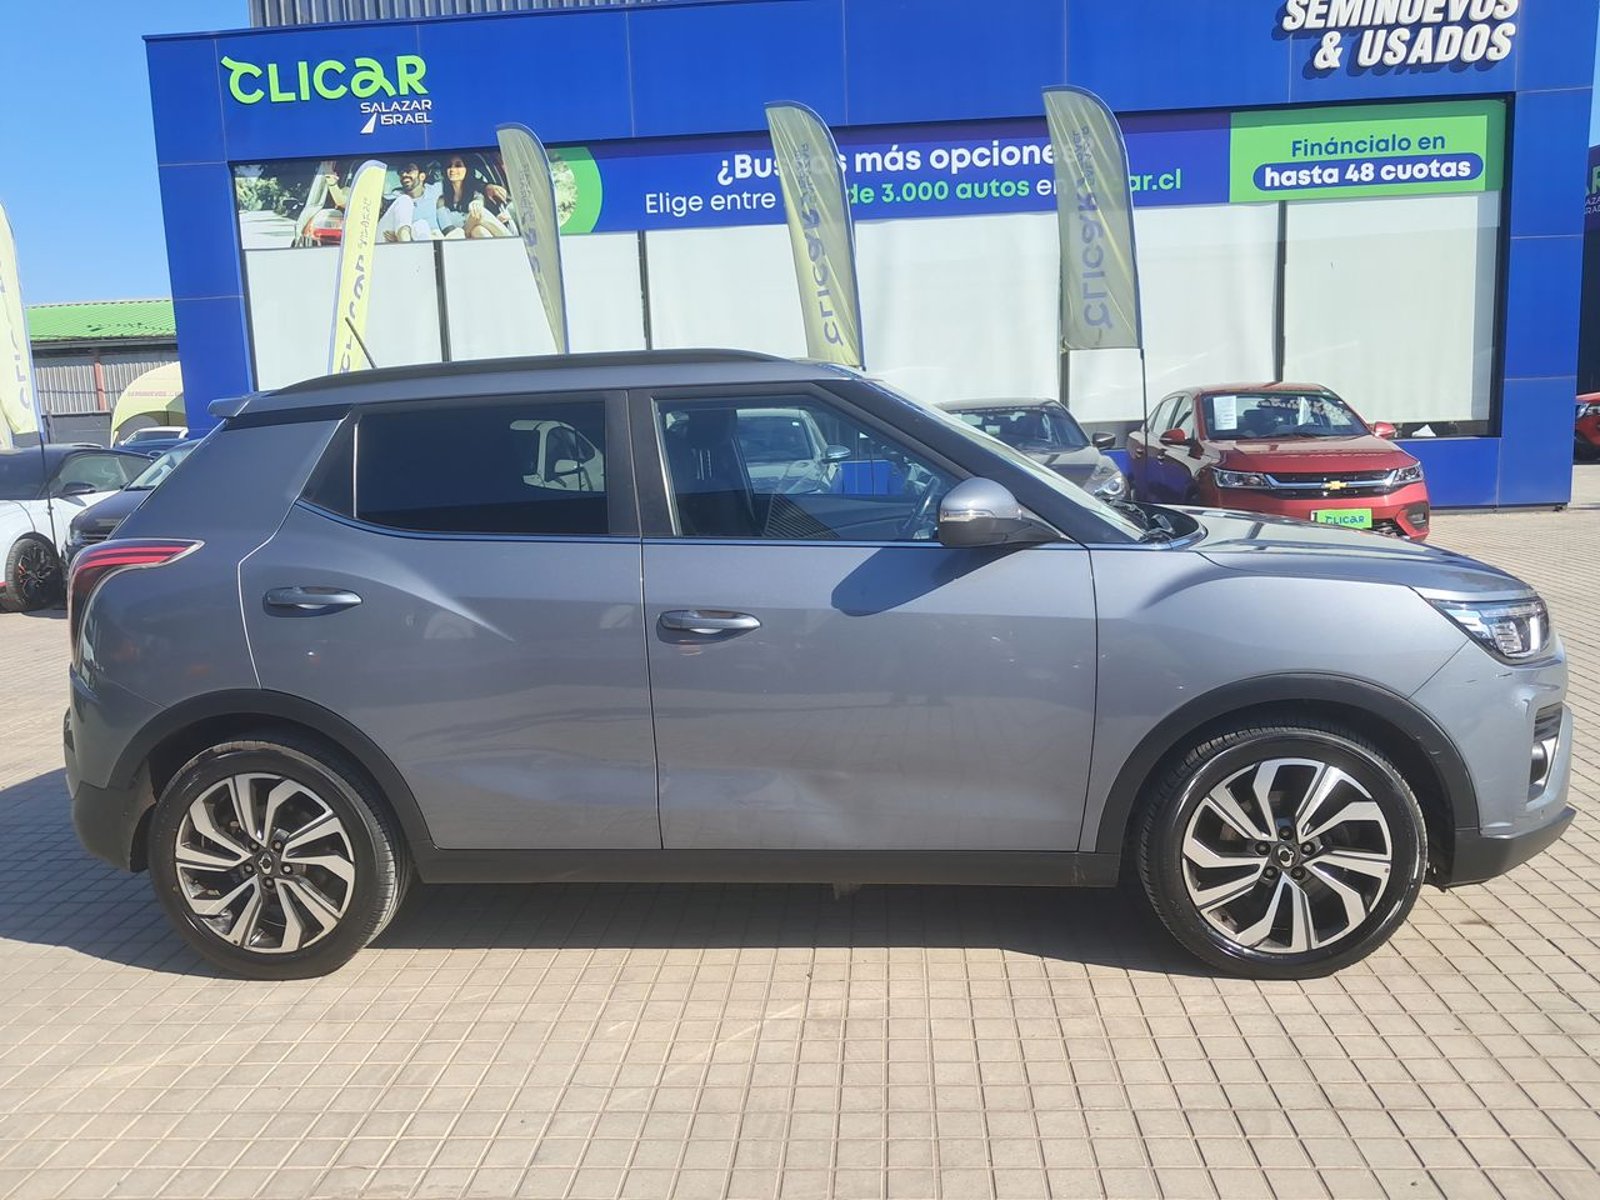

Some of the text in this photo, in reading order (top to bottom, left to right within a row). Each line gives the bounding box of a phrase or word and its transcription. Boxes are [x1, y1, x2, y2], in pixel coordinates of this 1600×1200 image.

[1282, 0, 1519, 31] SEMINUEVOS
[1313, 22, 1516, 69] & USADOS
[360, 100, 432, 114] SALAZAR
[380, 112, 432, 125] ISRAEL
[855, 145, 921, 173] más
[929, 139, 1056, 174] opcione
[1291, 134, 1446, 157] Fináncialo en
[1264, 159, 1471, 188] hasta 48 cuotas
[645, 192, 703, 217] Elige
[710, 191, 776, 210] entre
[881, 181, 949, 203] 3.000
[956, 178, 1029, 199] autos
[1036, 179, 1057, 196] e
